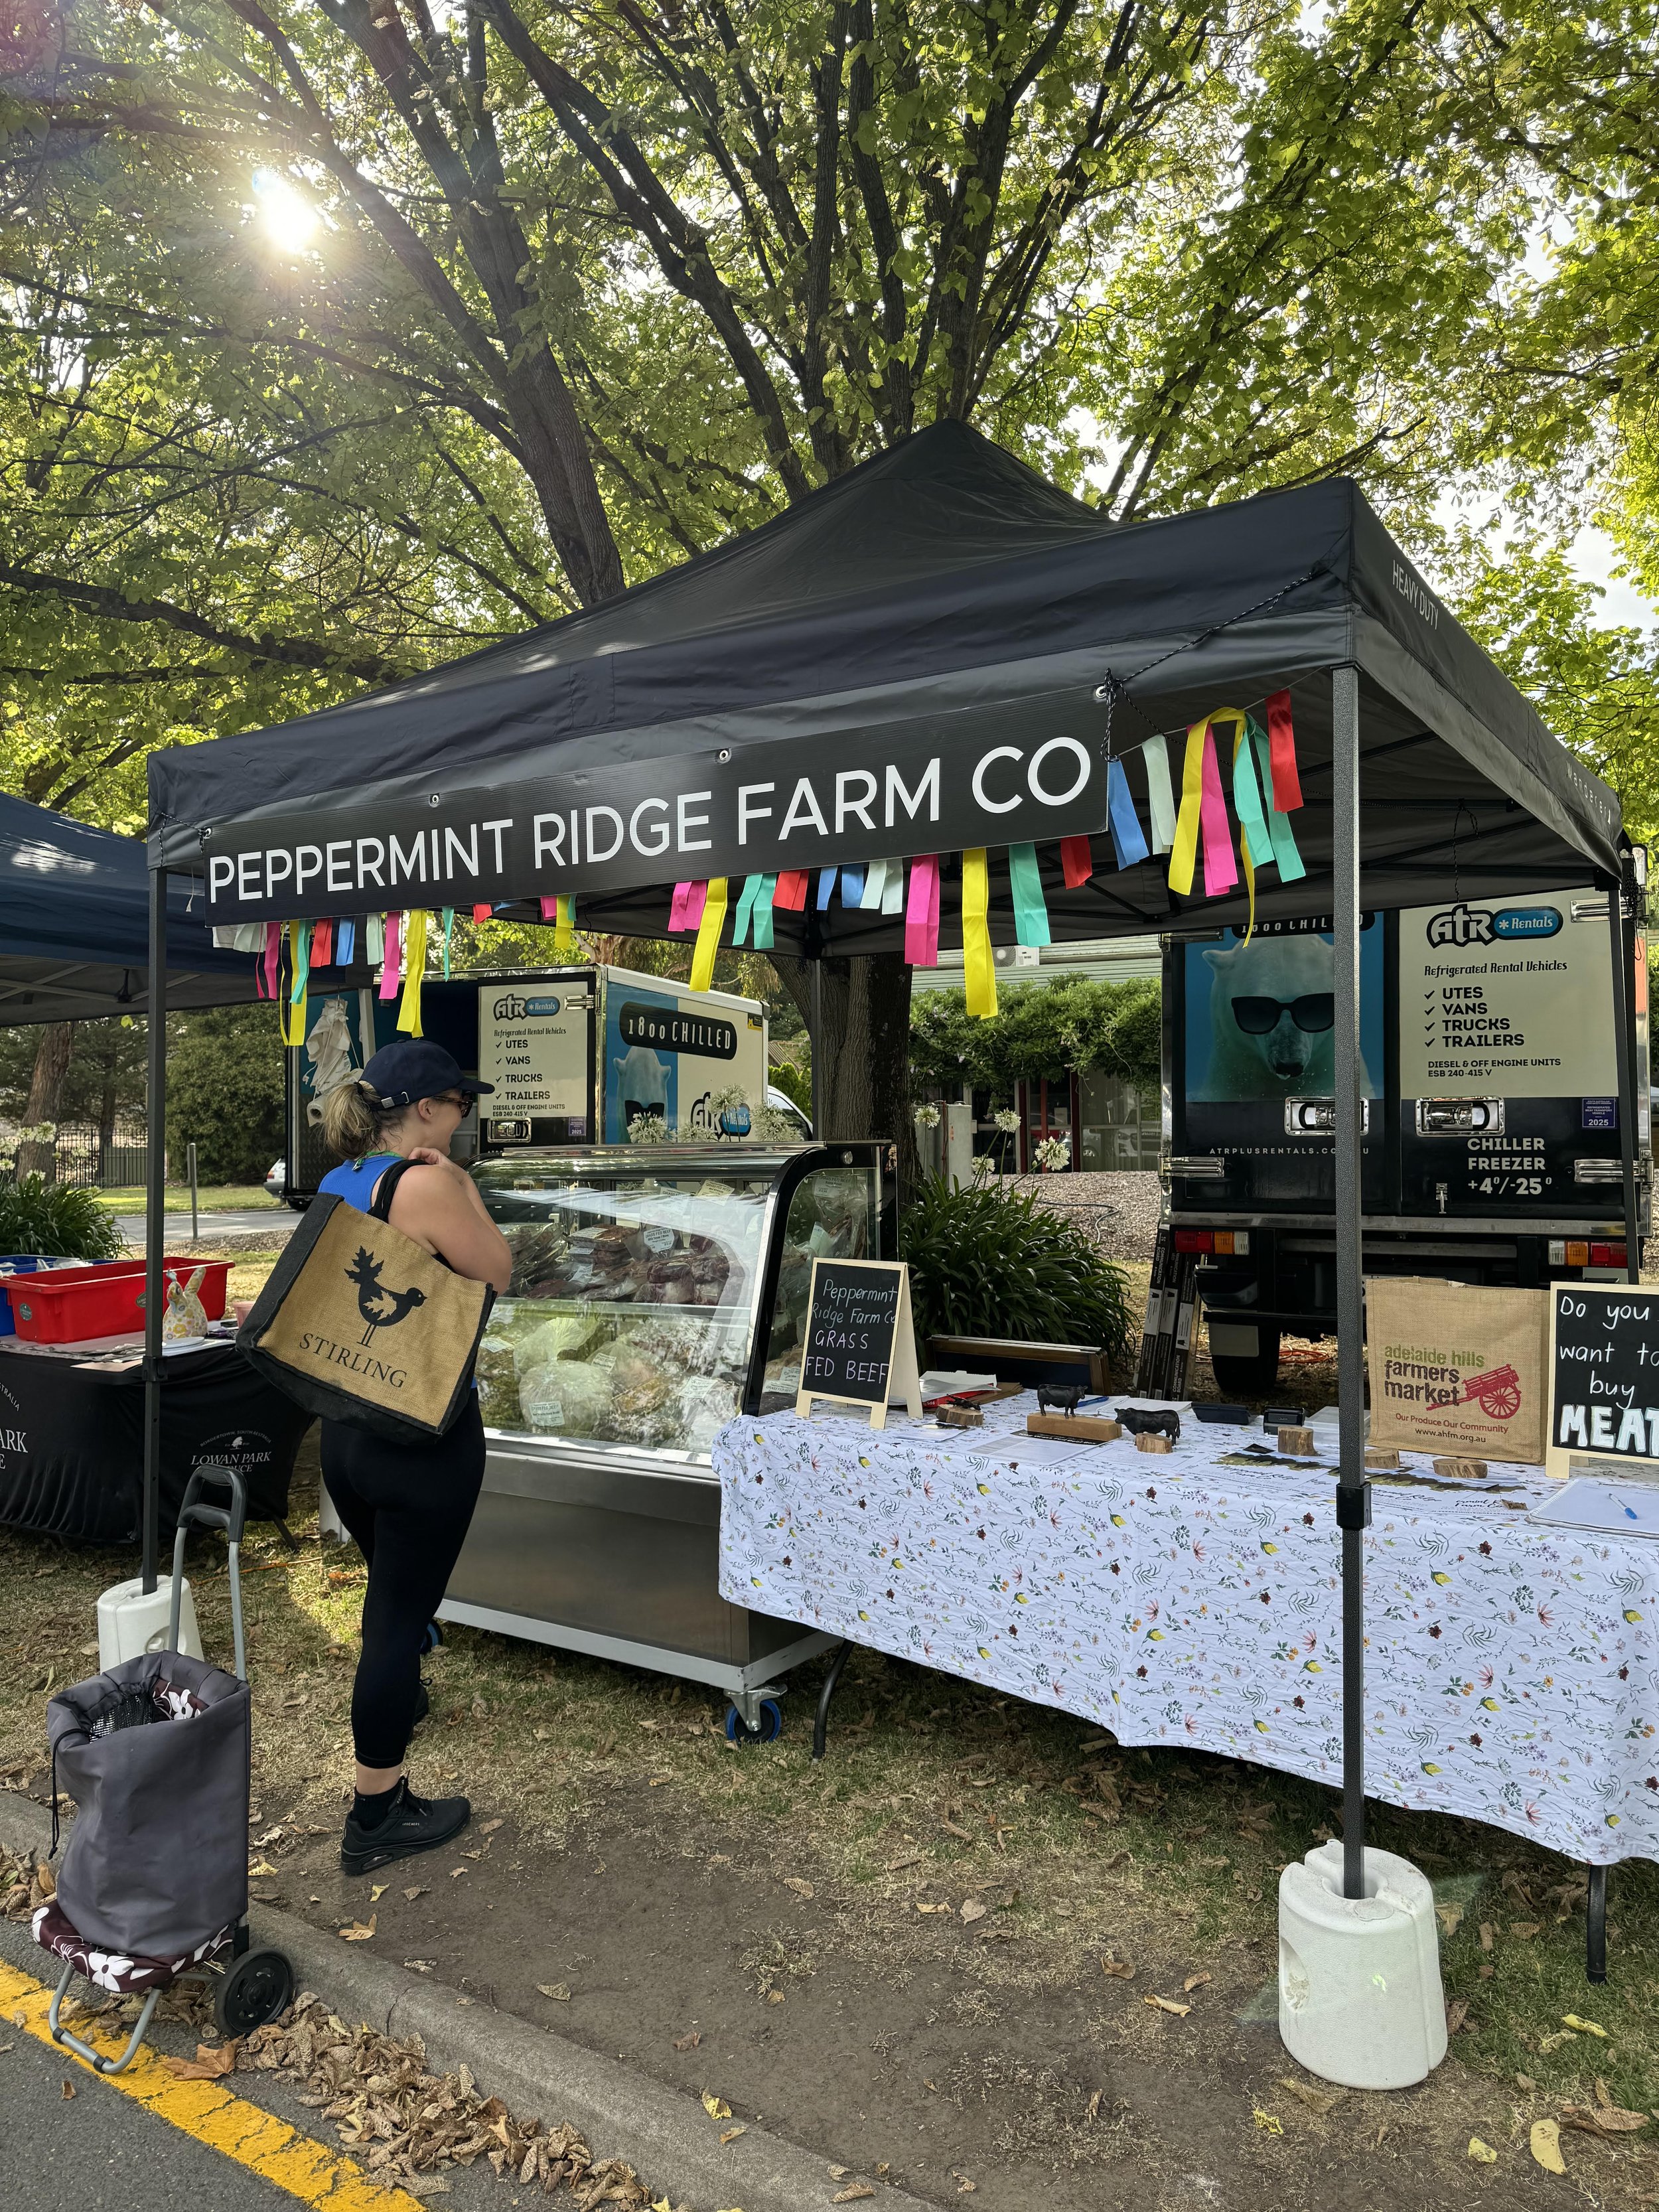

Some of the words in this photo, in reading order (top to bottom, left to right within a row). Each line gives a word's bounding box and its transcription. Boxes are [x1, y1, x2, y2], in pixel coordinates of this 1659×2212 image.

[1392, 559, 1419, 609] HEAVY
[1419, 589, 1438, 630] DUTY
[210, 818, 513, 903] PEPPERMINT
[533, 790, 711, 869] RIDGE
[739, 757, 940, 845] FARM
[972, 737, 1090, 814] CO
[1512, 916, 1553, 929] Rentals
[1424, 962, 1487, 978] Refrigerated
[1490, 961, 1524, 973] Rental
[1526, 960, 1567, 972] Vehicles
[1442, 986, 1483, 999] UTES
[535, 1002, 556, 1011] Rentals
[1442, 1002, 1488, 1015] VANS
[494, 1028, 526, 1038] Refrigerated
[628, 1016, 666, 1040] 1800
[672, 1021, 731, 1050] CHILLED
[1442, 1018, 1510, 1032] TRUCKS
[506, 1039, 528, 1049] UTES
[1442, 1033, 1525, 1047] TRAILERS
[506, 1056, 531, 1065] VANS
[1531, 1058, 1561, 1067] UNITS
[505, 1073, 543, 1083] TRUCKS
[505, 1090, 551, 1100] TRAILERS
[1467, 1138, 1546, 1151] CHILLER
[1468, 1157, 1546, 1170] FREEZER
[1157, 1247, 1165, 1284] COMMUNICATION
[823, 1279, 898, 1307] Peppermint
[812, 1302, 844, 1329] Ridge
[850, 1308, 881, 1325] Farm
[1560, 1295, 1587, 1317] Do
[1603, 1305, 1650, 1330] you
[815, 1329, 869, 1349] GRASS
[299, 1333, 407, 1388] STIRLING
[1384, 1343, 1447, 1365] adelaide
[1451, 1349, 1485, 1368] hills
[1559, 1341, 1615, 1363] want
[1636, 1342, 1659, 1366] to
[805, 1356, 835, 1376] FED
[846, 1360, 891, 1384] BEEF
[1384, 1359, 1460, 1384] farmers
[1384, 1380, 1460, 1407] market
[1589, 1370, 1635, 1410] buy
[1396, 1413, 1409, 1422] Our
[1410, 1414, 1442, 1427] Produce
[1443, 1420, 1459, 1428] Our
[1459, 1422, 1508, 1434] Community
[1415, 1428, 1486, 1443] www.ahfm.org.au
[190, 1453, 240, 1465] LOWAN
[241, 1451, 272, 1463] PARK
